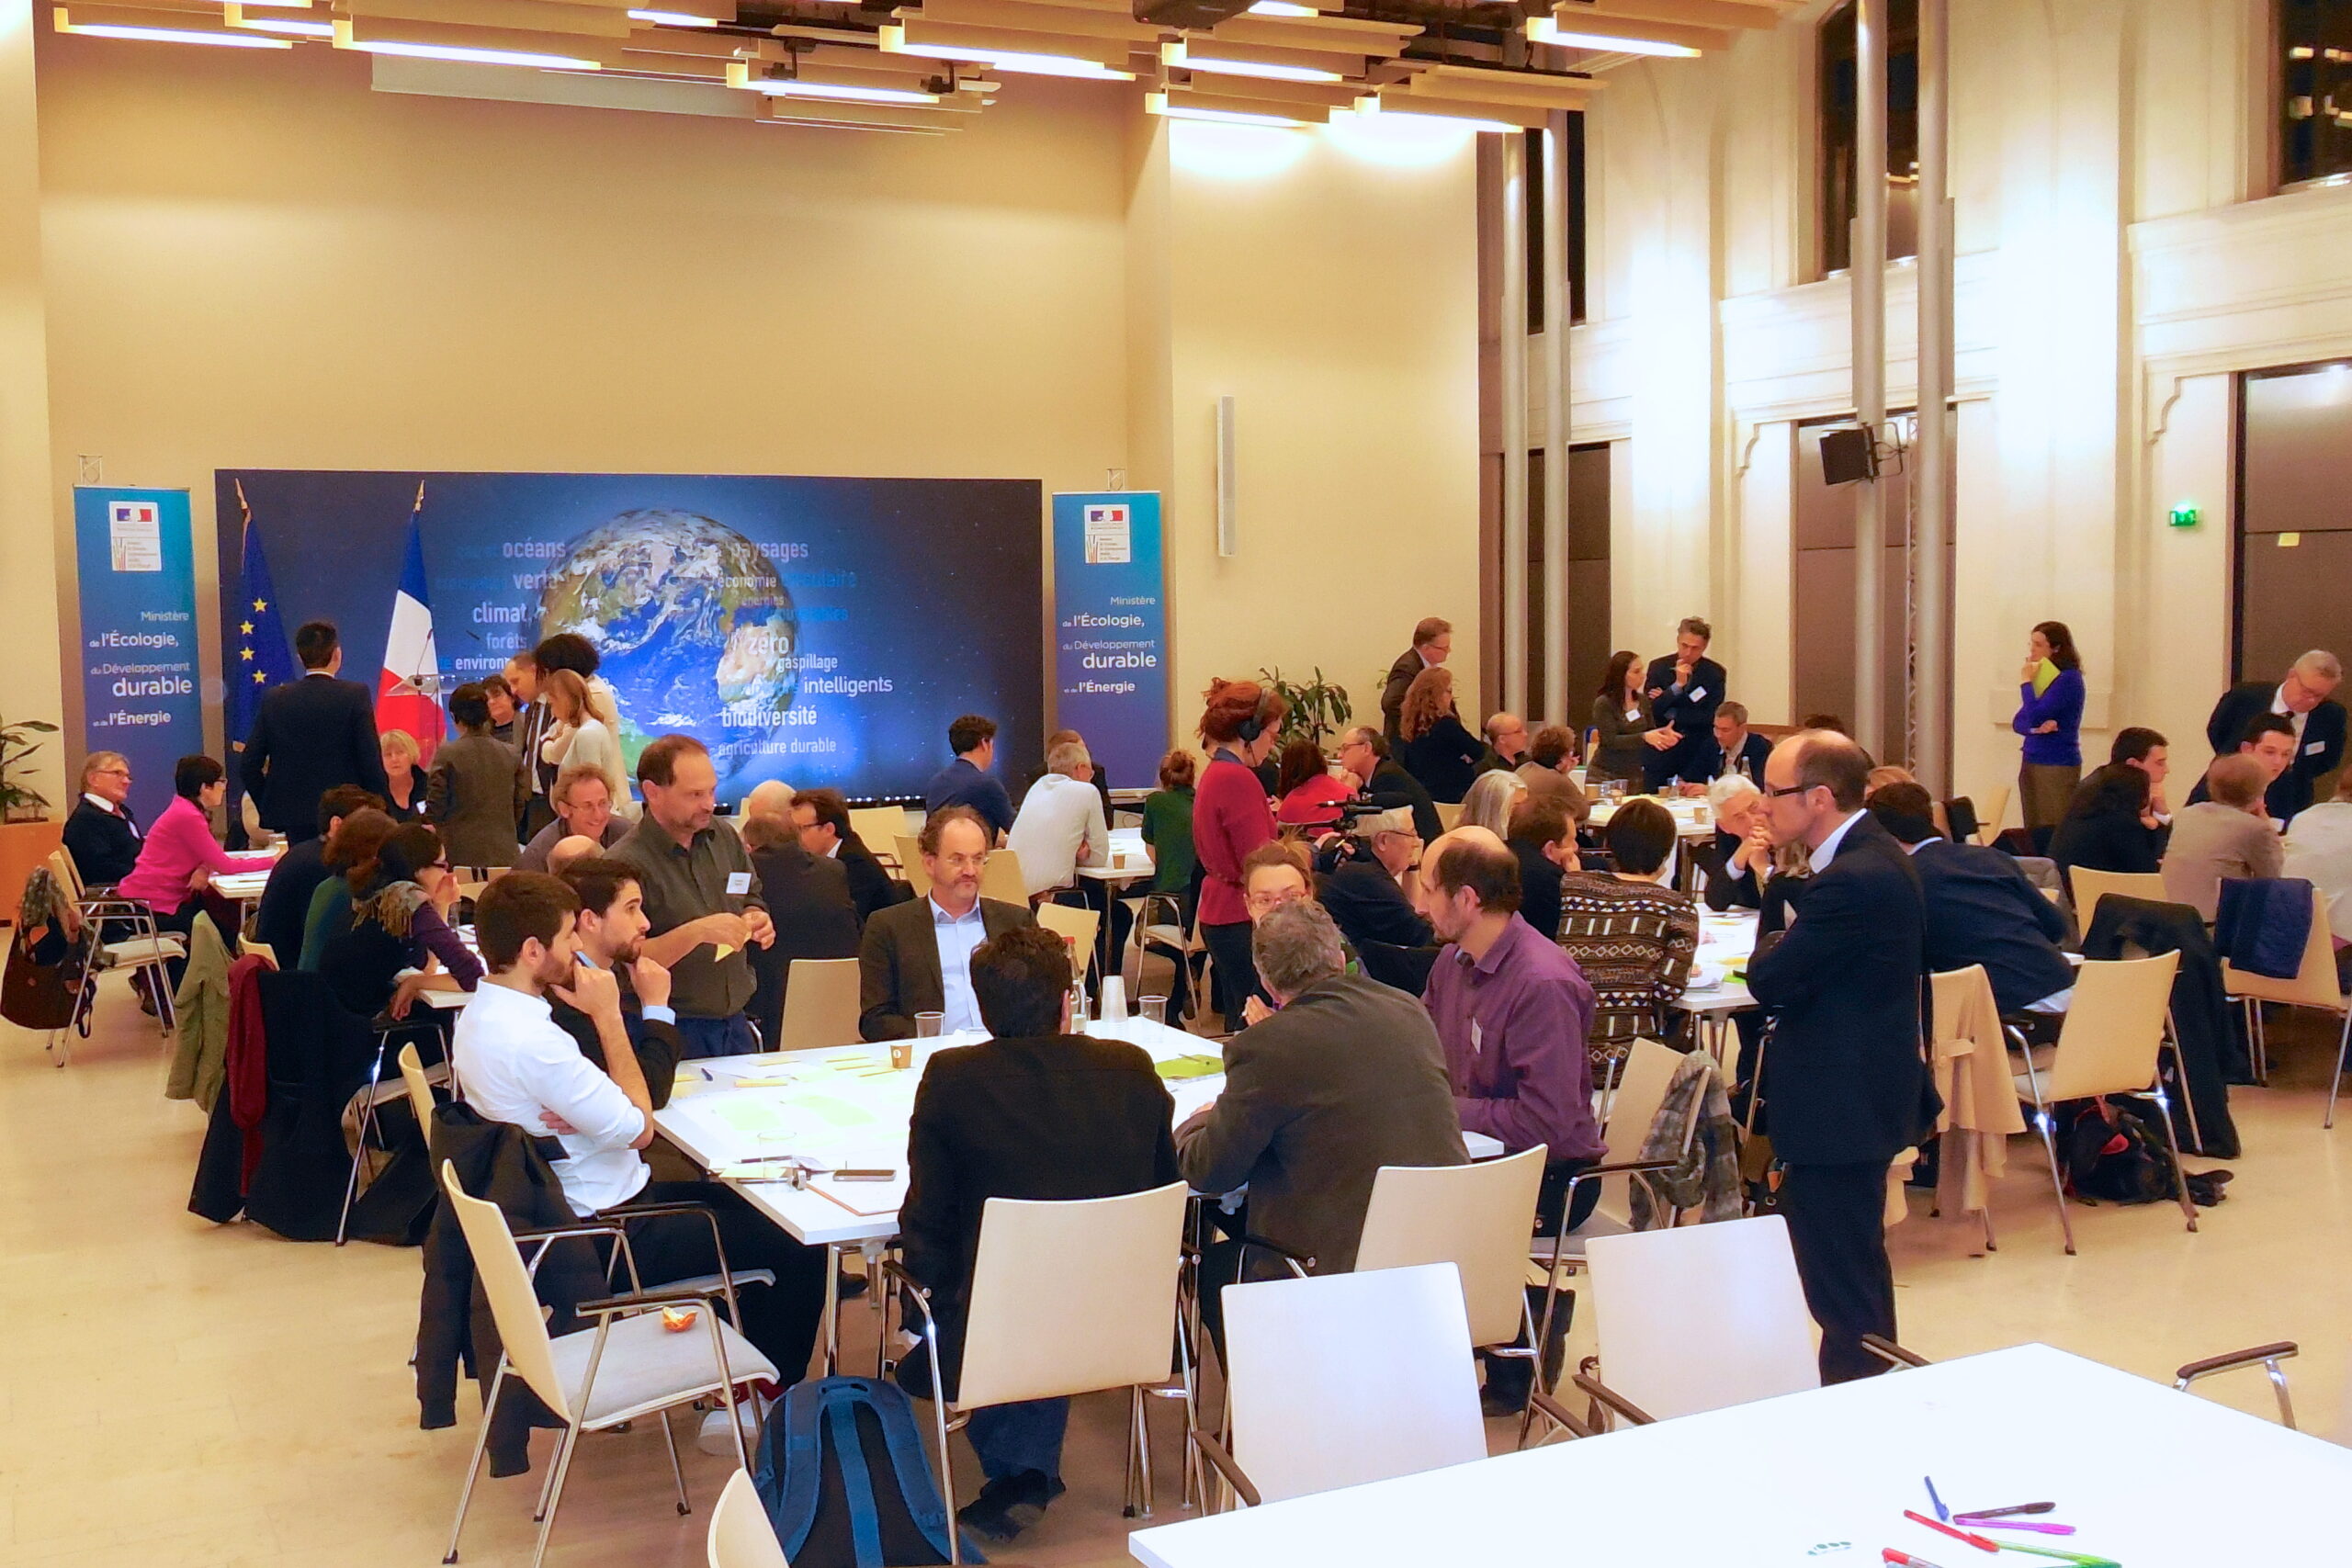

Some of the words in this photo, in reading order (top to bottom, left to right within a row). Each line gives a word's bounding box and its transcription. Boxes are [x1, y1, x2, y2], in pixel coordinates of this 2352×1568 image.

[503, 537, 566, 558] océans
[731, 542, 808, 563] paysages
[1110, 596, 1156, 605] Ministère
[141, 611, 189, 622] Ministère
[472, 602, 527, 624] climat
[1073, 612, 1145, 628] l'Écologie,
[101, 629, 179, 648] l'Écologie,
[486, 632, 527, 649] forêts
[1074, 639, 1155, 650] Développement
[102, 662, 190, 675] Développement
[775, 653, 838, 672] gaspillage
[1082, 651, 1157, 669] durable
[112, 675, 193, 697] durable
[804, 676, 894, 697] intelligents
[1079, 680, 1136, 694] l'Énergie
[108, 709, 172, 727] l'Énergie
[721, 705, 817, 728] biodiversité
[718, 739, 787, 759] agriculture
[790, 737, 837, 754] durable
